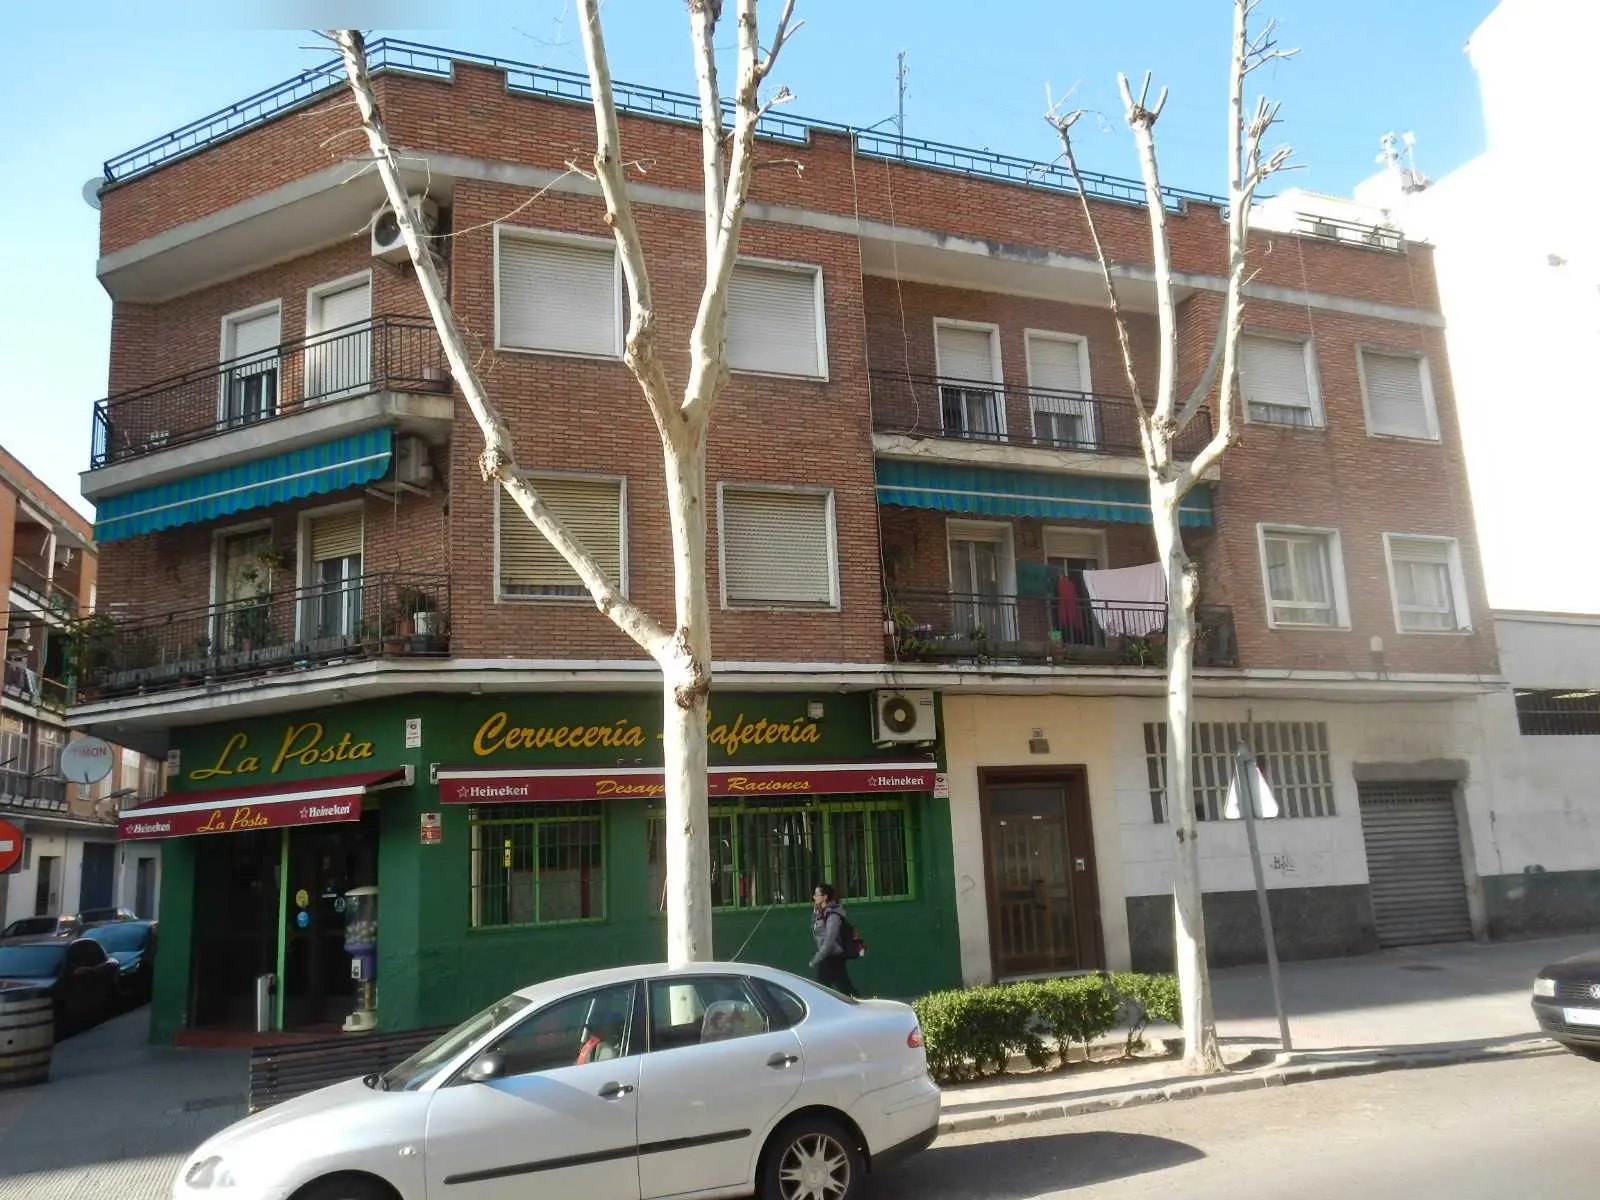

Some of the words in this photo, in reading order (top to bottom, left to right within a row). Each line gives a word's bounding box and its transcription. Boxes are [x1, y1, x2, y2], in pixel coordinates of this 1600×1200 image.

[473, 711, 646, 756] Cervecería
[706, 710, 820, 756] afetería
[189, 732, 261, 780] La
[271, 722, 374, 774] Posta
[595, 780, 665, 797] Desay
[727, 777, 812, 791] Raciones
[877, 775, 925, 787] Heineken
[469, 785, 528, 797] Heineken
[309, 802, 352, 818] Heineken
[132, 820, 172, 833] Heineken
[196, 811, 225, 832] La
[230, 807, 268, 830] Posta
